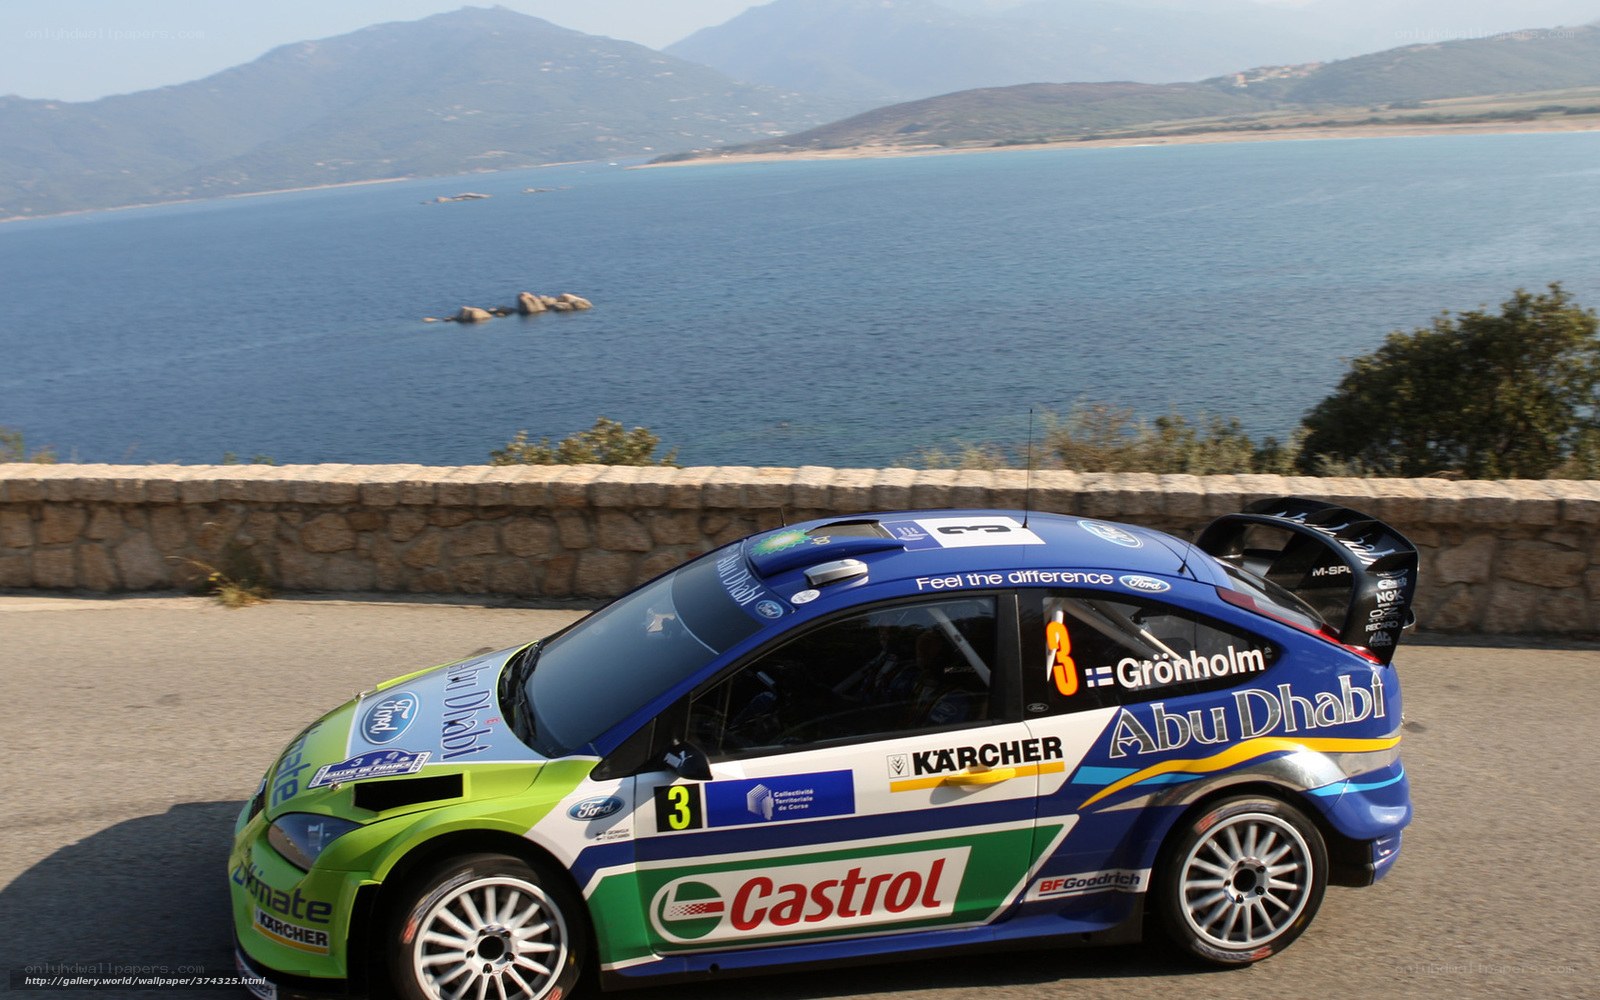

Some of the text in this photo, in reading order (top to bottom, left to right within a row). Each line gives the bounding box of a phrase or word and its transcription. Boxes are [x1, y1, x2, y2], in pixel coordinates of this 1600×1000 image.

[723, 569, 766, 606] Dhabi
[915, 569, 1114, 591] Feel the difference
[1128, 575, 1162, 591] Ford
[1376, 590, 1404, 603] NGK
[1046, 620, 1079, 697] 3
[1116, 646, 1266, 690] Grönholm
[369, 698, 413, 734] Ford
[441, 689, 493, 761] Dhabi
[1109, 671, 1385, 759] Abu Dhabi
[912, 736, 1064, 776] KÄRCHER
[577, 799, 614, 818] Ford
[668, 785, 691, 830] 3
[773, 788, 814, 798] Collectivité
[775, 796, 813, 805] Territoriale
[788, 803, 809, 811] Corse
[729, 857, 947, 932] Castrol
[1040, 872, 1140, 892] BFGoodrich
